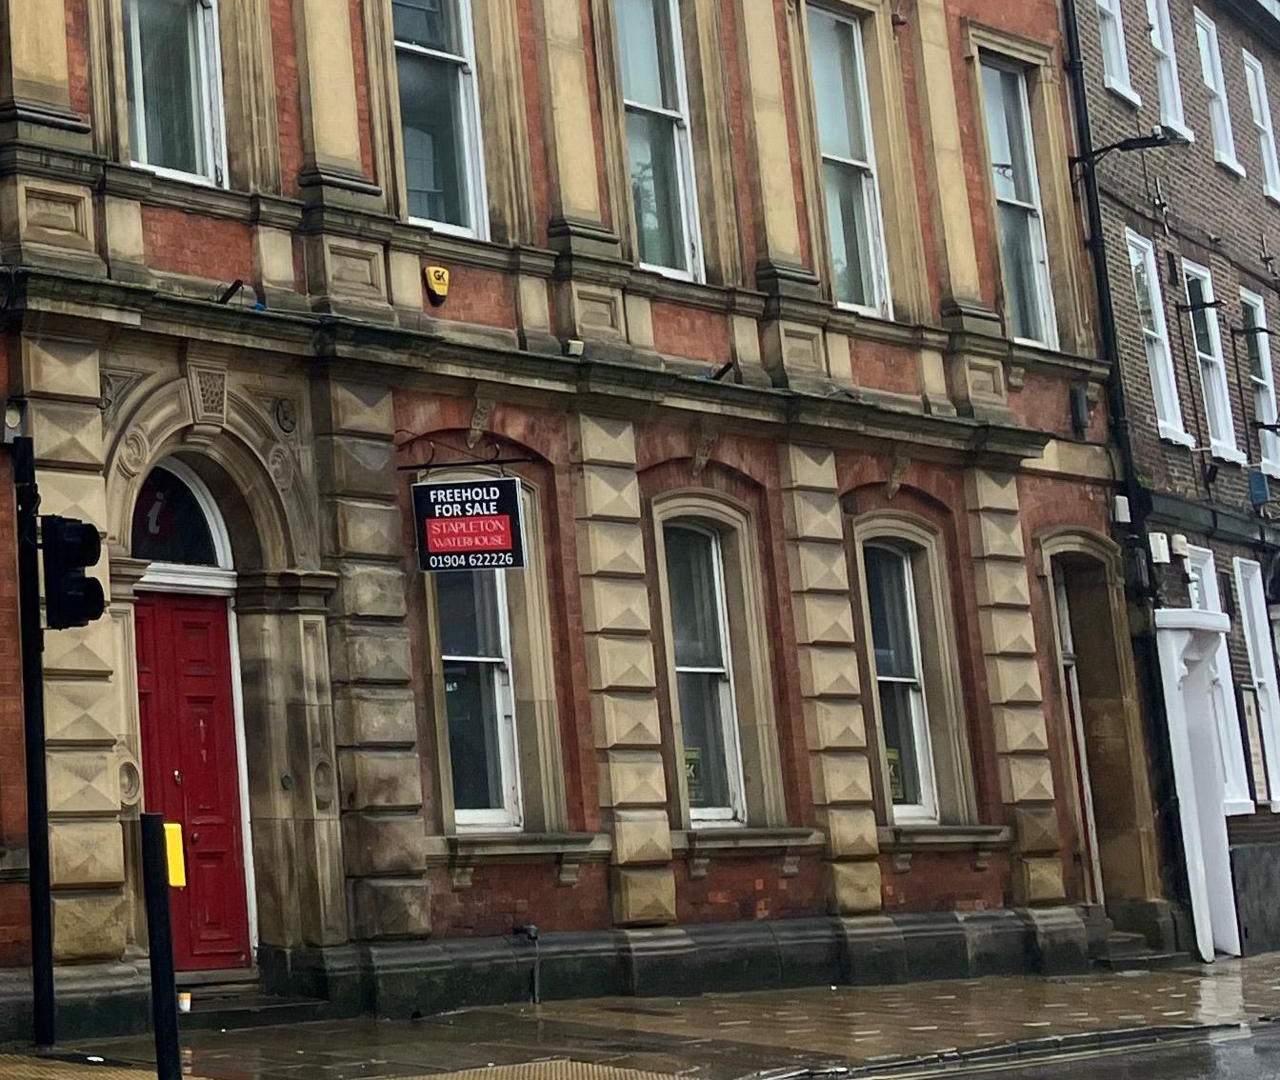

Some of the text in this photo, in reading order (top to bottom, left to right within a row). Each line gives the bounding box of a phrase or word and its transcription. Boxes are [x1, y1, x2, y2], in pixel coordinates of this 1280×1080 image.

[433, 270, 446, 282] GK
[429, 486, 500, 503] FREEHOLD
[434, 502, 498, 517] FOR SALE
[431, 520, 505, 534] STAPLETON
[432, 535, 505, 548] WATERHOUSE
[429, 552, 514, 568] 01904 622226
